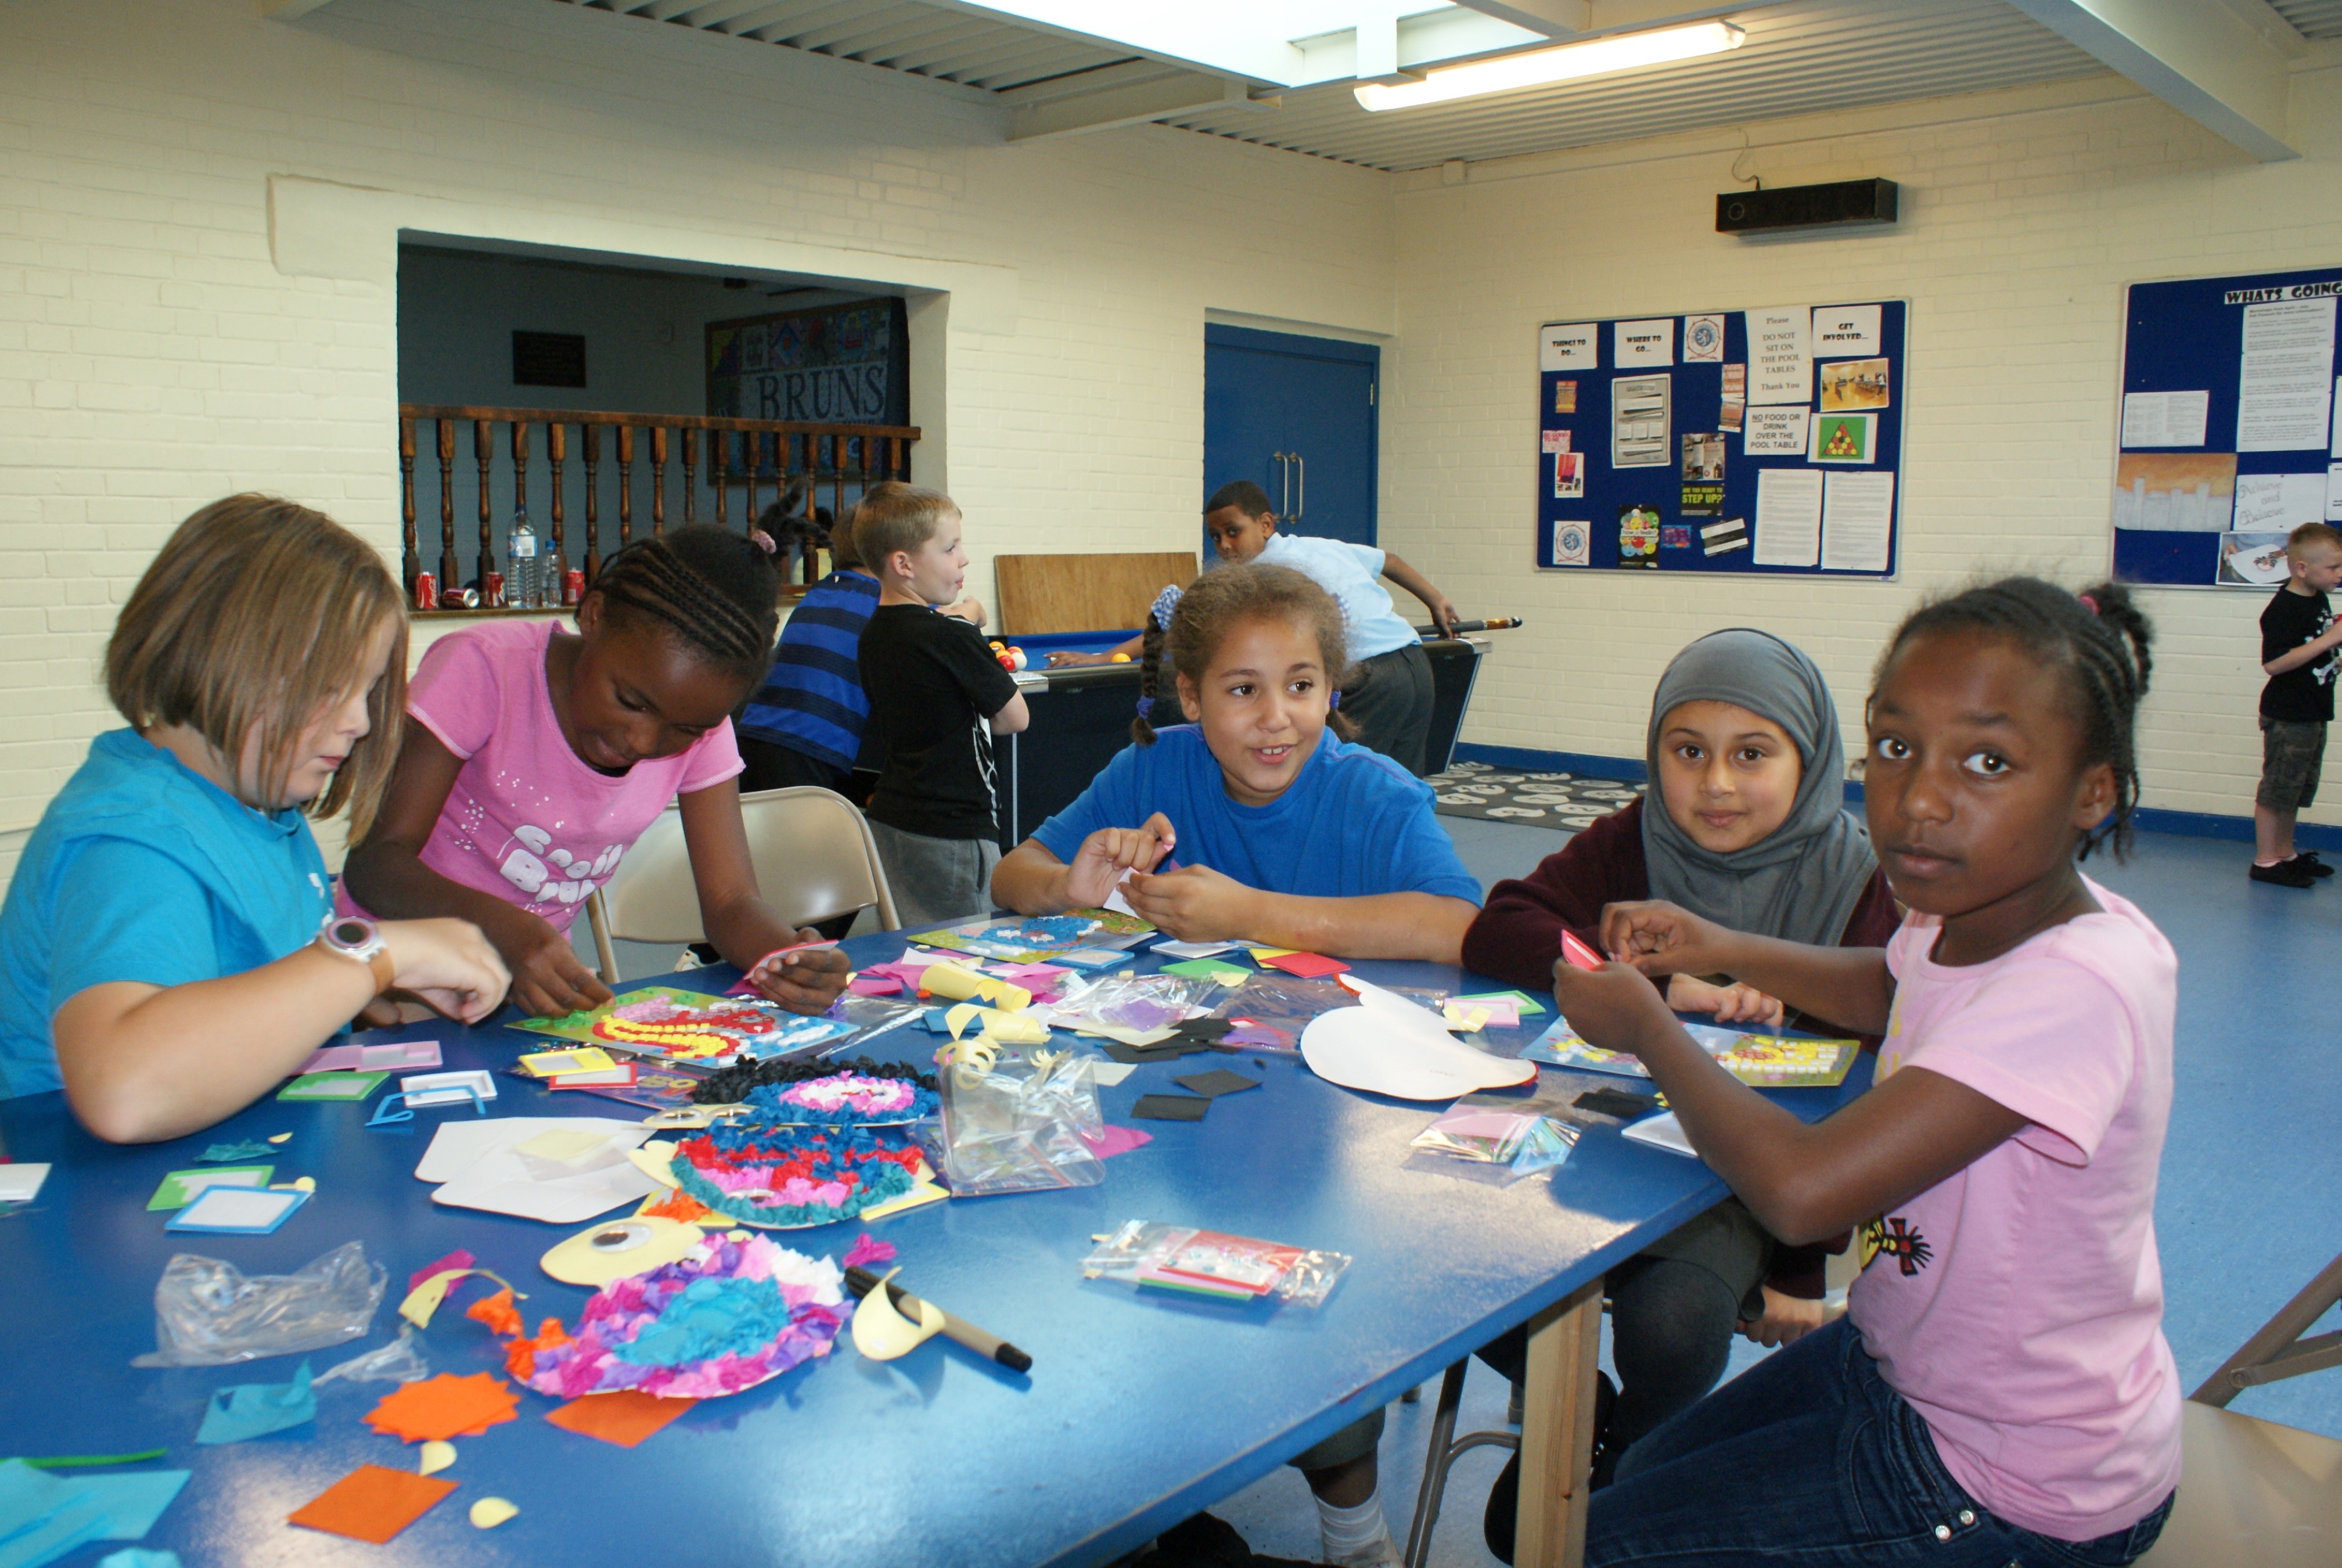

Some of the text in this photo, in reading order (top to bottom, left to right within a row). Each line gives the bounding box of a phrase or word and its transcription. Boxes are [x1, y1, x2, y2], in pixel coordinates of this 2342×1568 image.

[2226, 282, 2342, 303] WHATS GOING
[1765, 366, 1796, 374] TABLES
[757, 365, 885, 420] BRUNS
[1682, 494, 1722, 504] STEP UP?
[2261, 491, 2280, 505] and
